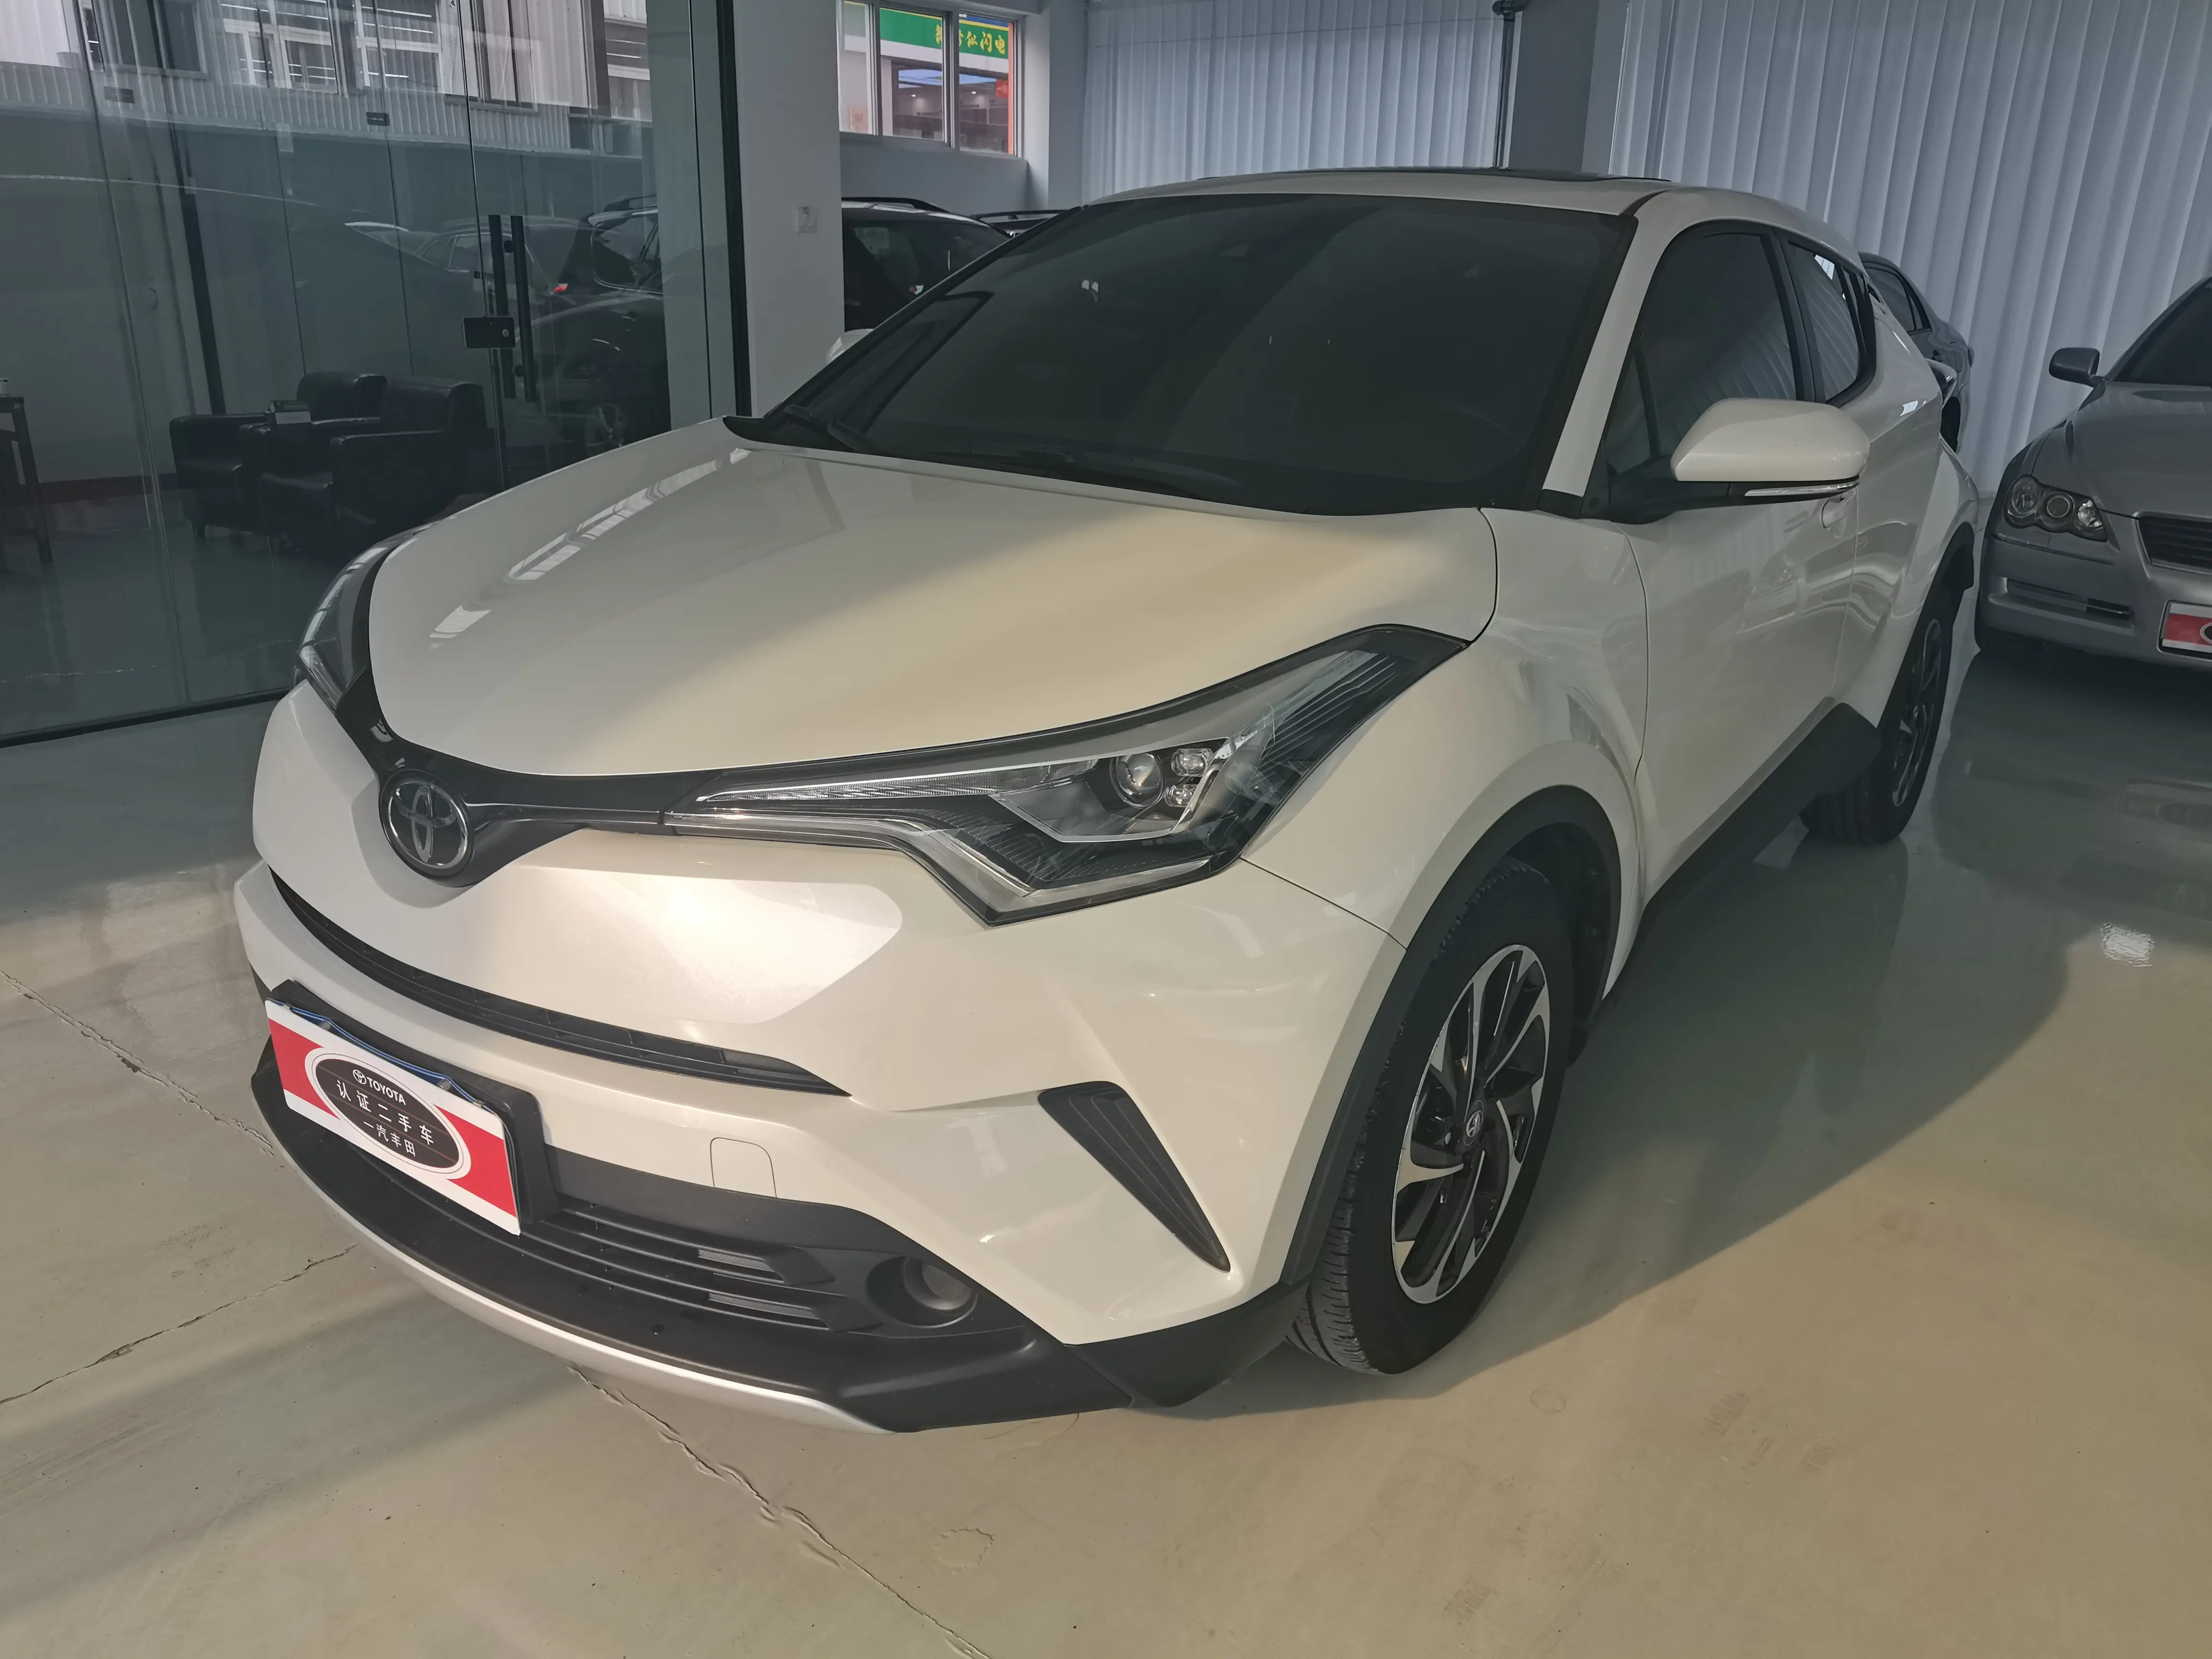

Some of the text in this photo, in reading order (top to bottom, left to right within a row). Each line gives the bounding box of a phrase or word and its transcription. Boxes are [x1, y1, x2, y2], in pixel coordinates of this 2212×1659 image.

[366, 1077, 406, 1106] TOYOTA
[336, 1080, 434, 1145] 认证二手车
[363, 1121, 416, 1157] 一汽丰田
